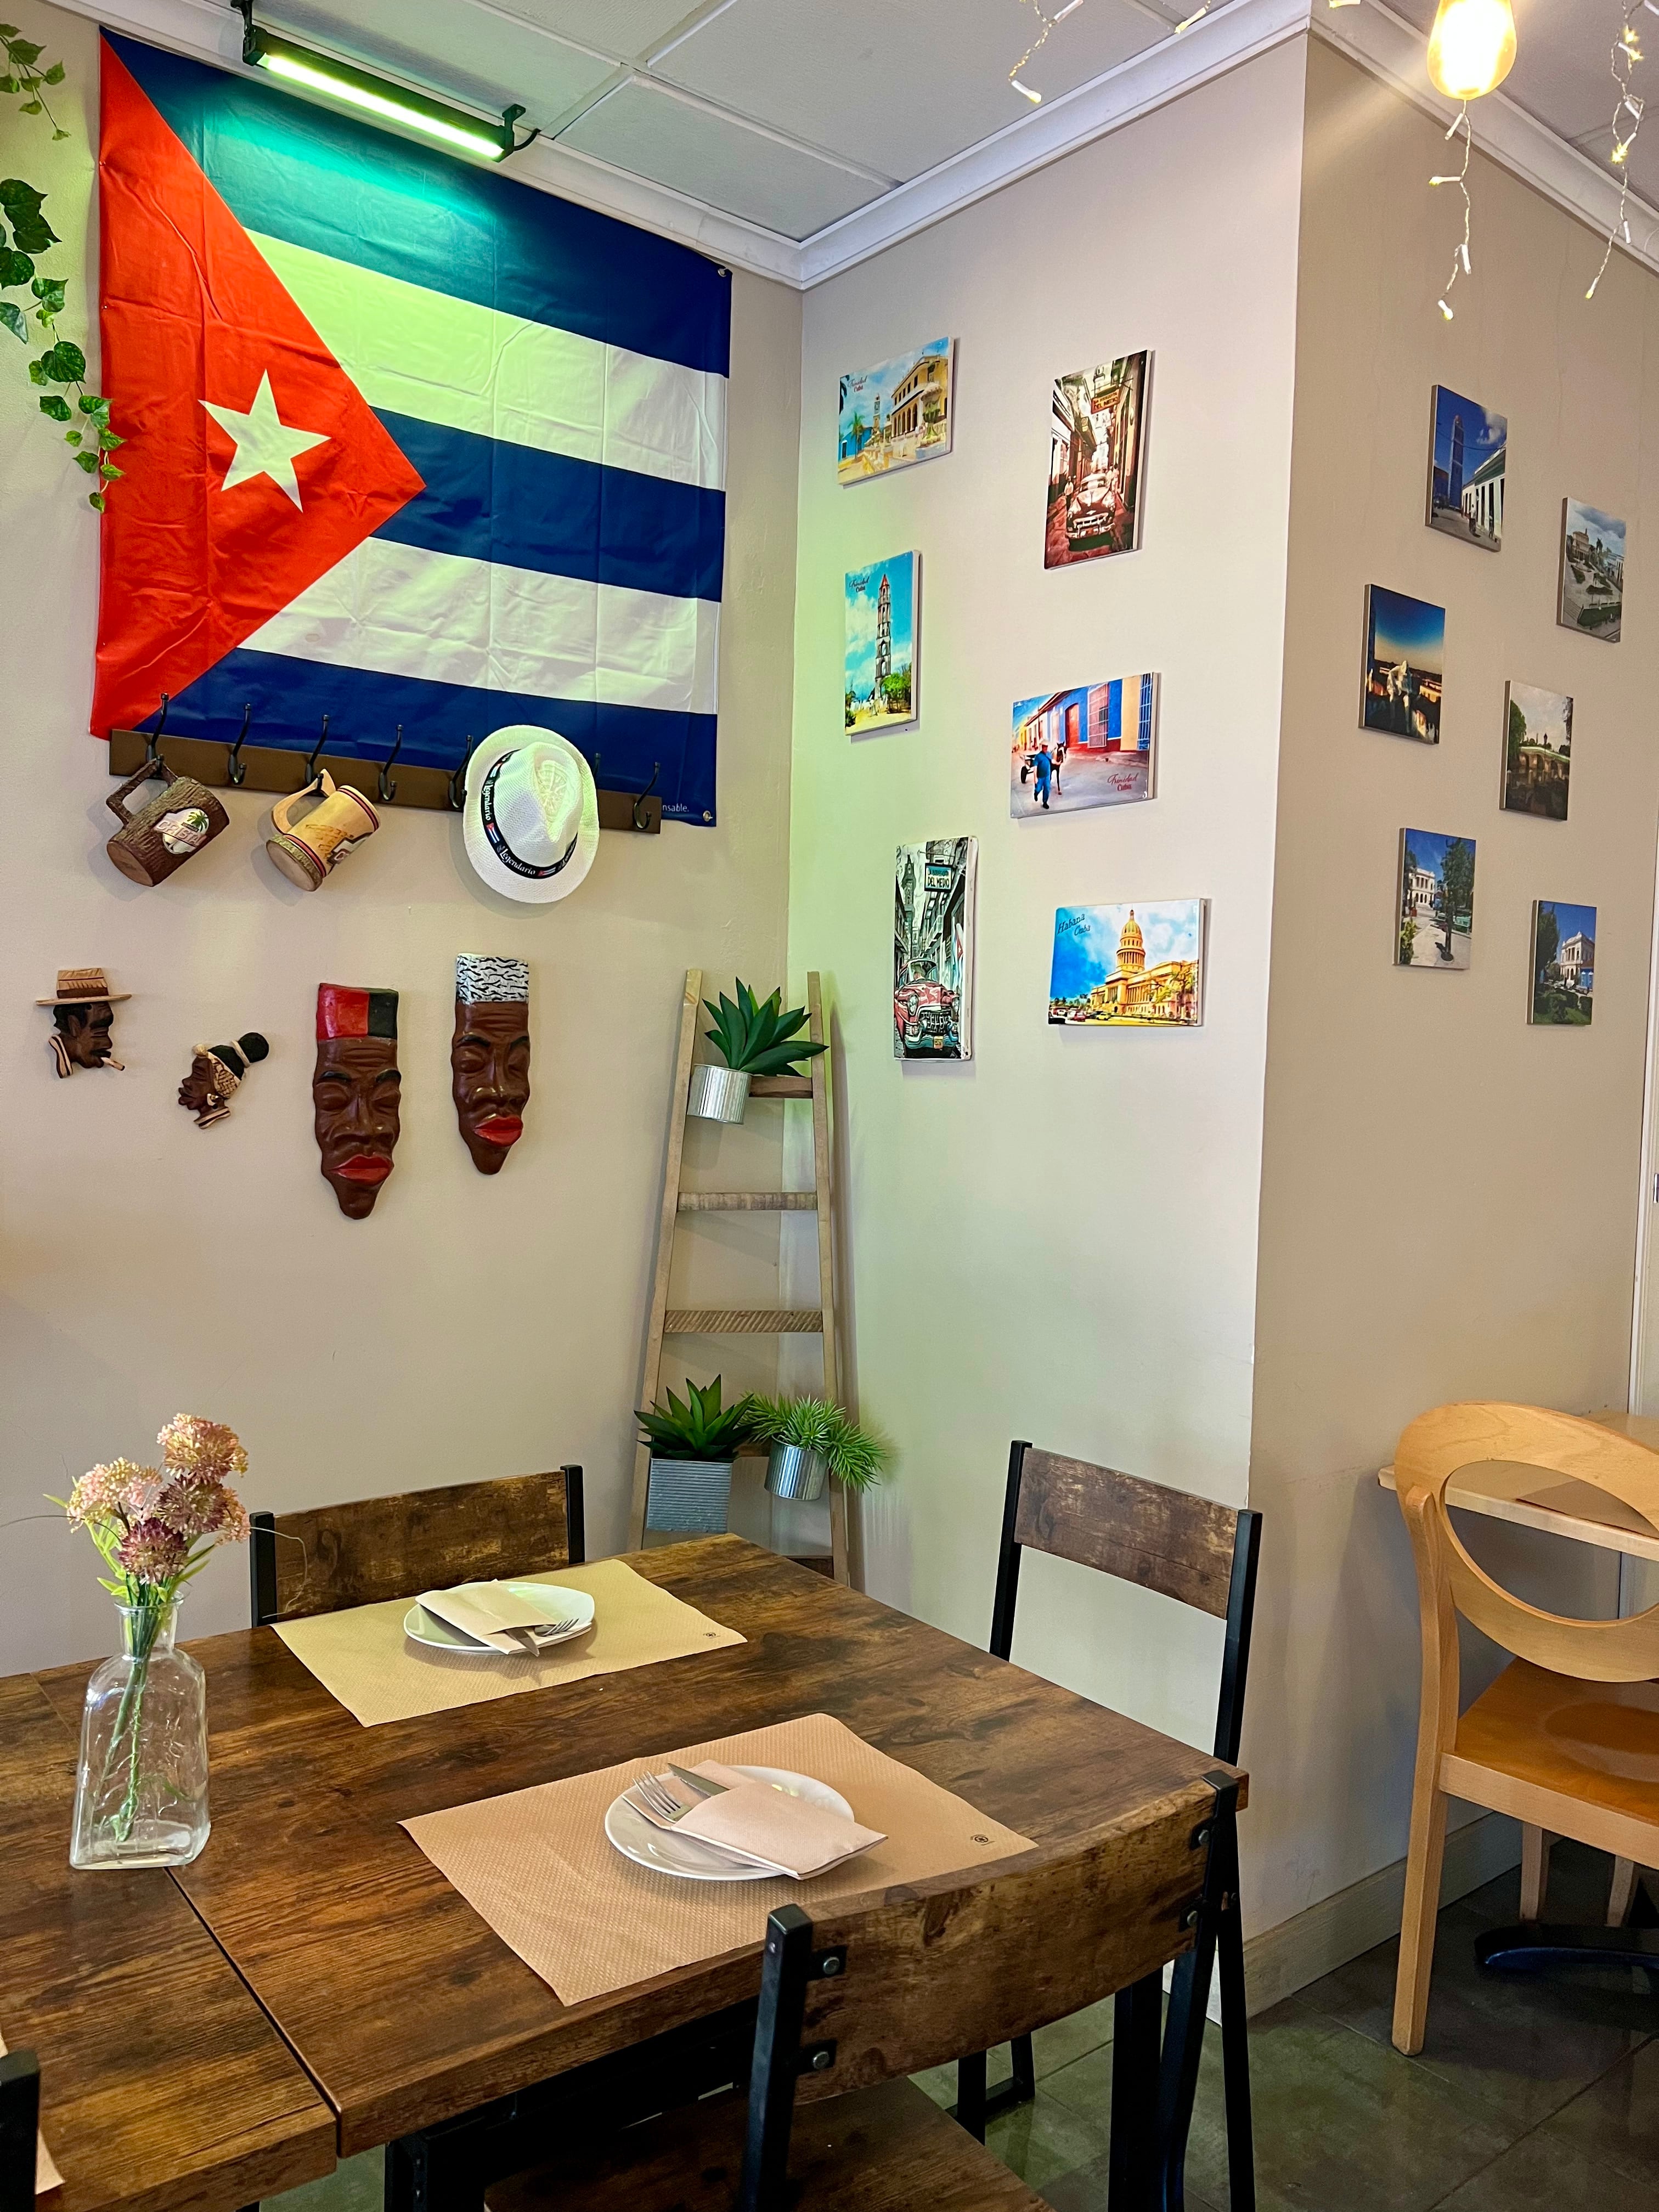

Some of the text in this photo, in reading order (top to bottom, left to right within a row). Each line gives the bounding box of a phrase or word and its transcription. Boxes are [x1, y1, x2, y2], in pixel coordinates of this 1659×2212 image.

[1107, 772, 1139, 786] Trinidad
[500, 848, 536, 875] Legendario
[1057, 913, 1085, 935] Habana
